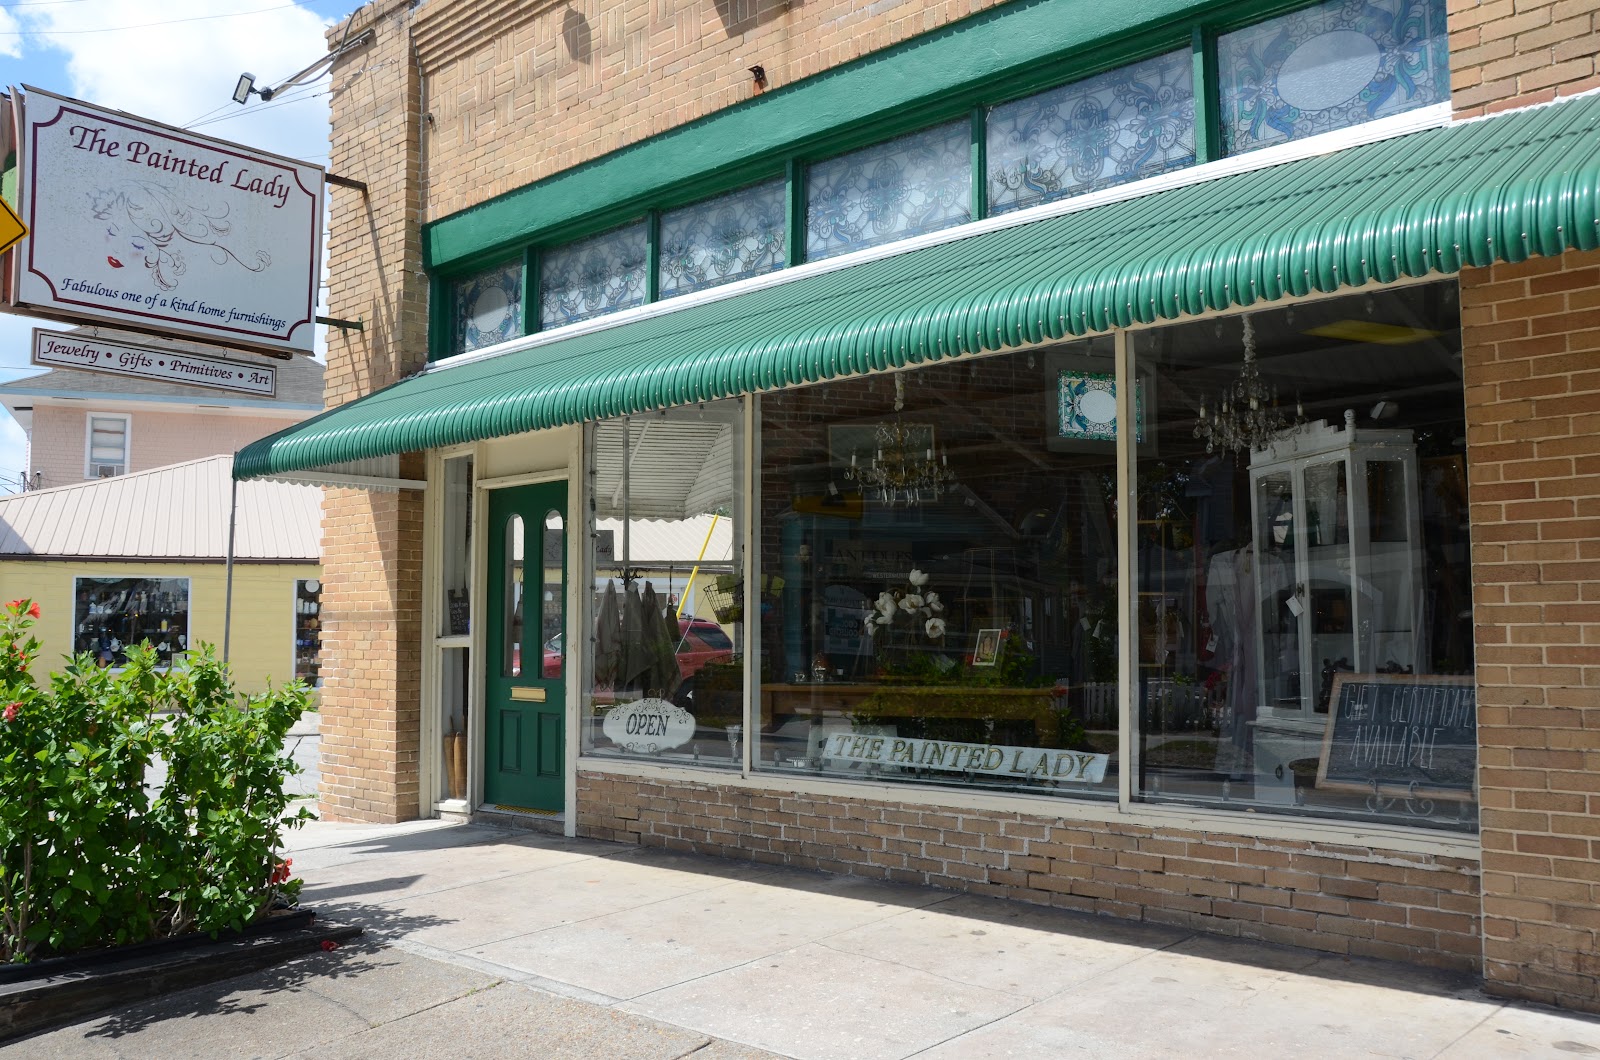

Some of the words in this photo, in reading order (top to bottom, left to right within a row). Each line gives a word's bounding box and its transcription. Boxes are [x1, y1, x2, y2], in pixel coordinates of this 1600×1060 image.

[69, 125, 121, 157] The
[126, 141, 229, 184] Painted
[230, 168, 291, 208] Lady
[61, 277, 119, 299] Fabulous
[121, 291, 142, 303] one
[144, 293, 160, 310] of
[160, 298, 168, 307] a
[169, 296, 198, 313] kind
[197, 301, 226, 318] home
[225, 307, 286, 332] furnishings
[43, 341, 100, 364] Jewelry
[119, 352, 154, 370] Gifts
[170, 359, 233, 380] Primitives
[247, 372, 270, 385] Art
[626, 713, 670, 737] OPEN
[1344, 684, 1381, 722] GIFT
[834, 735, 884, 760] THE
[887, 739, 1004, 771] PAINTED
[1009, 749, 1096, 779] LADY
[1349, 723, 1446, 770] AVAILABLE
